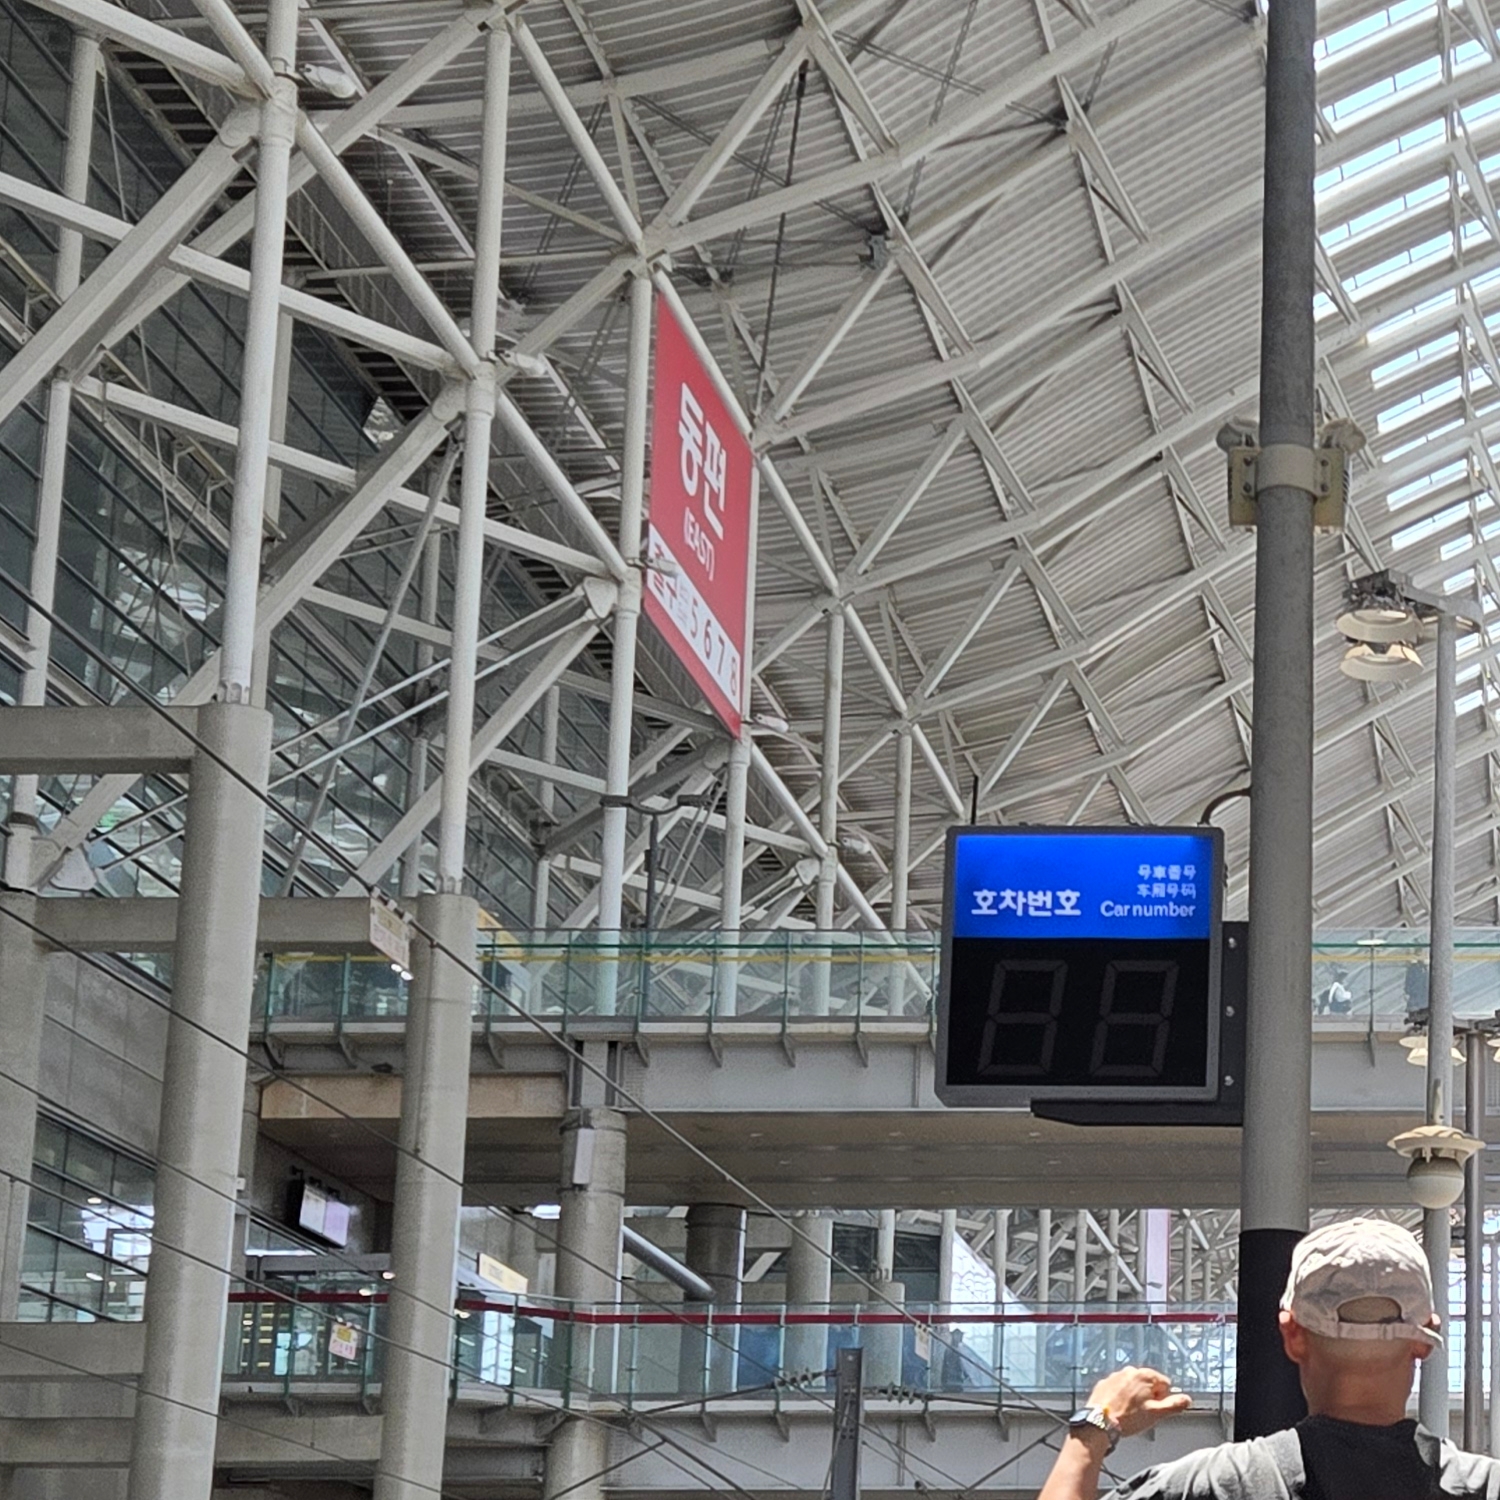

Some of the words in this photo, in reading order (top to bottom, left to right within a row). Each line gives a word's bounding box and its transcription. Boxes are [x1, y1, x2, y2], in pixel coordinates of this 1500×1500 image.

[679, 382, 726, 541] 동편
[690, 597, 699, 639] 5
[704, 618, 712, 660] 6
[717, 634, 726, 676] 7
[730, 656, 738, 697] 8
[971, 888, 1082, 917] 호차번호
[1100, 900, 1126, 917] Car
[1132, 901, 1196, 917] number
